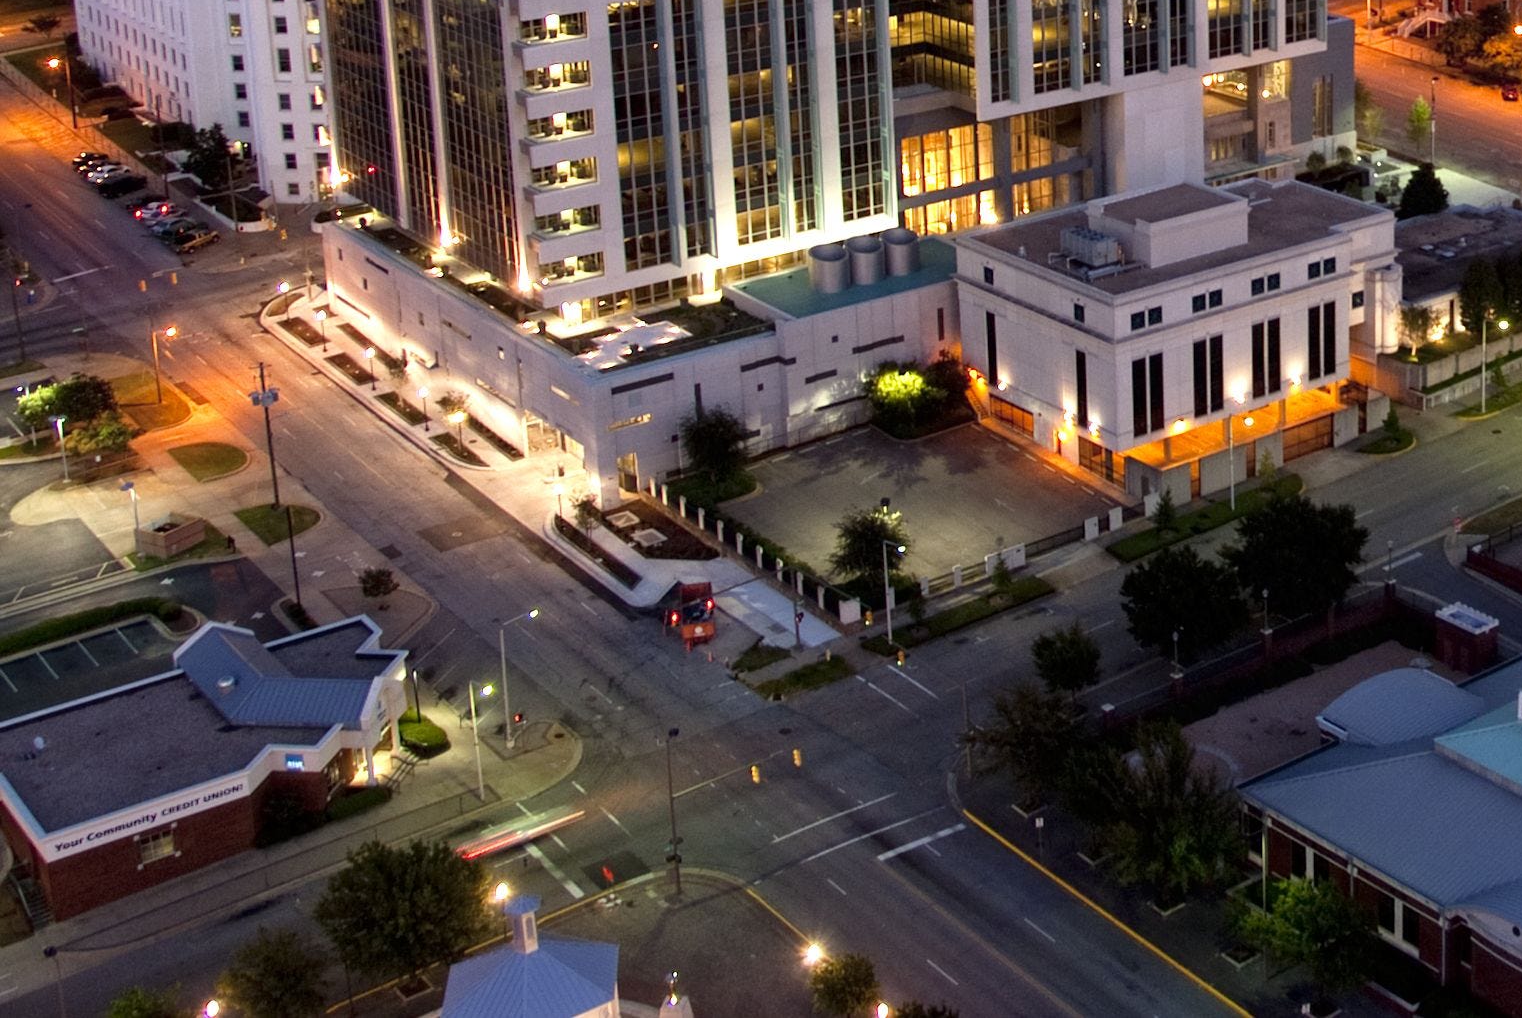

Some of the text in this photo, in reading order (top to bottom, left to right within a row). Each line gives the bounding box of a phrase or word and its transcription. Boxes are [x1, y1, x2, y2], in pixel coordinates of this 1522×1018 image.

[54, 837, 84, 852] Your
[86, 813, 158, 841] Community
[160, 797, 201, 817] CREDIT
